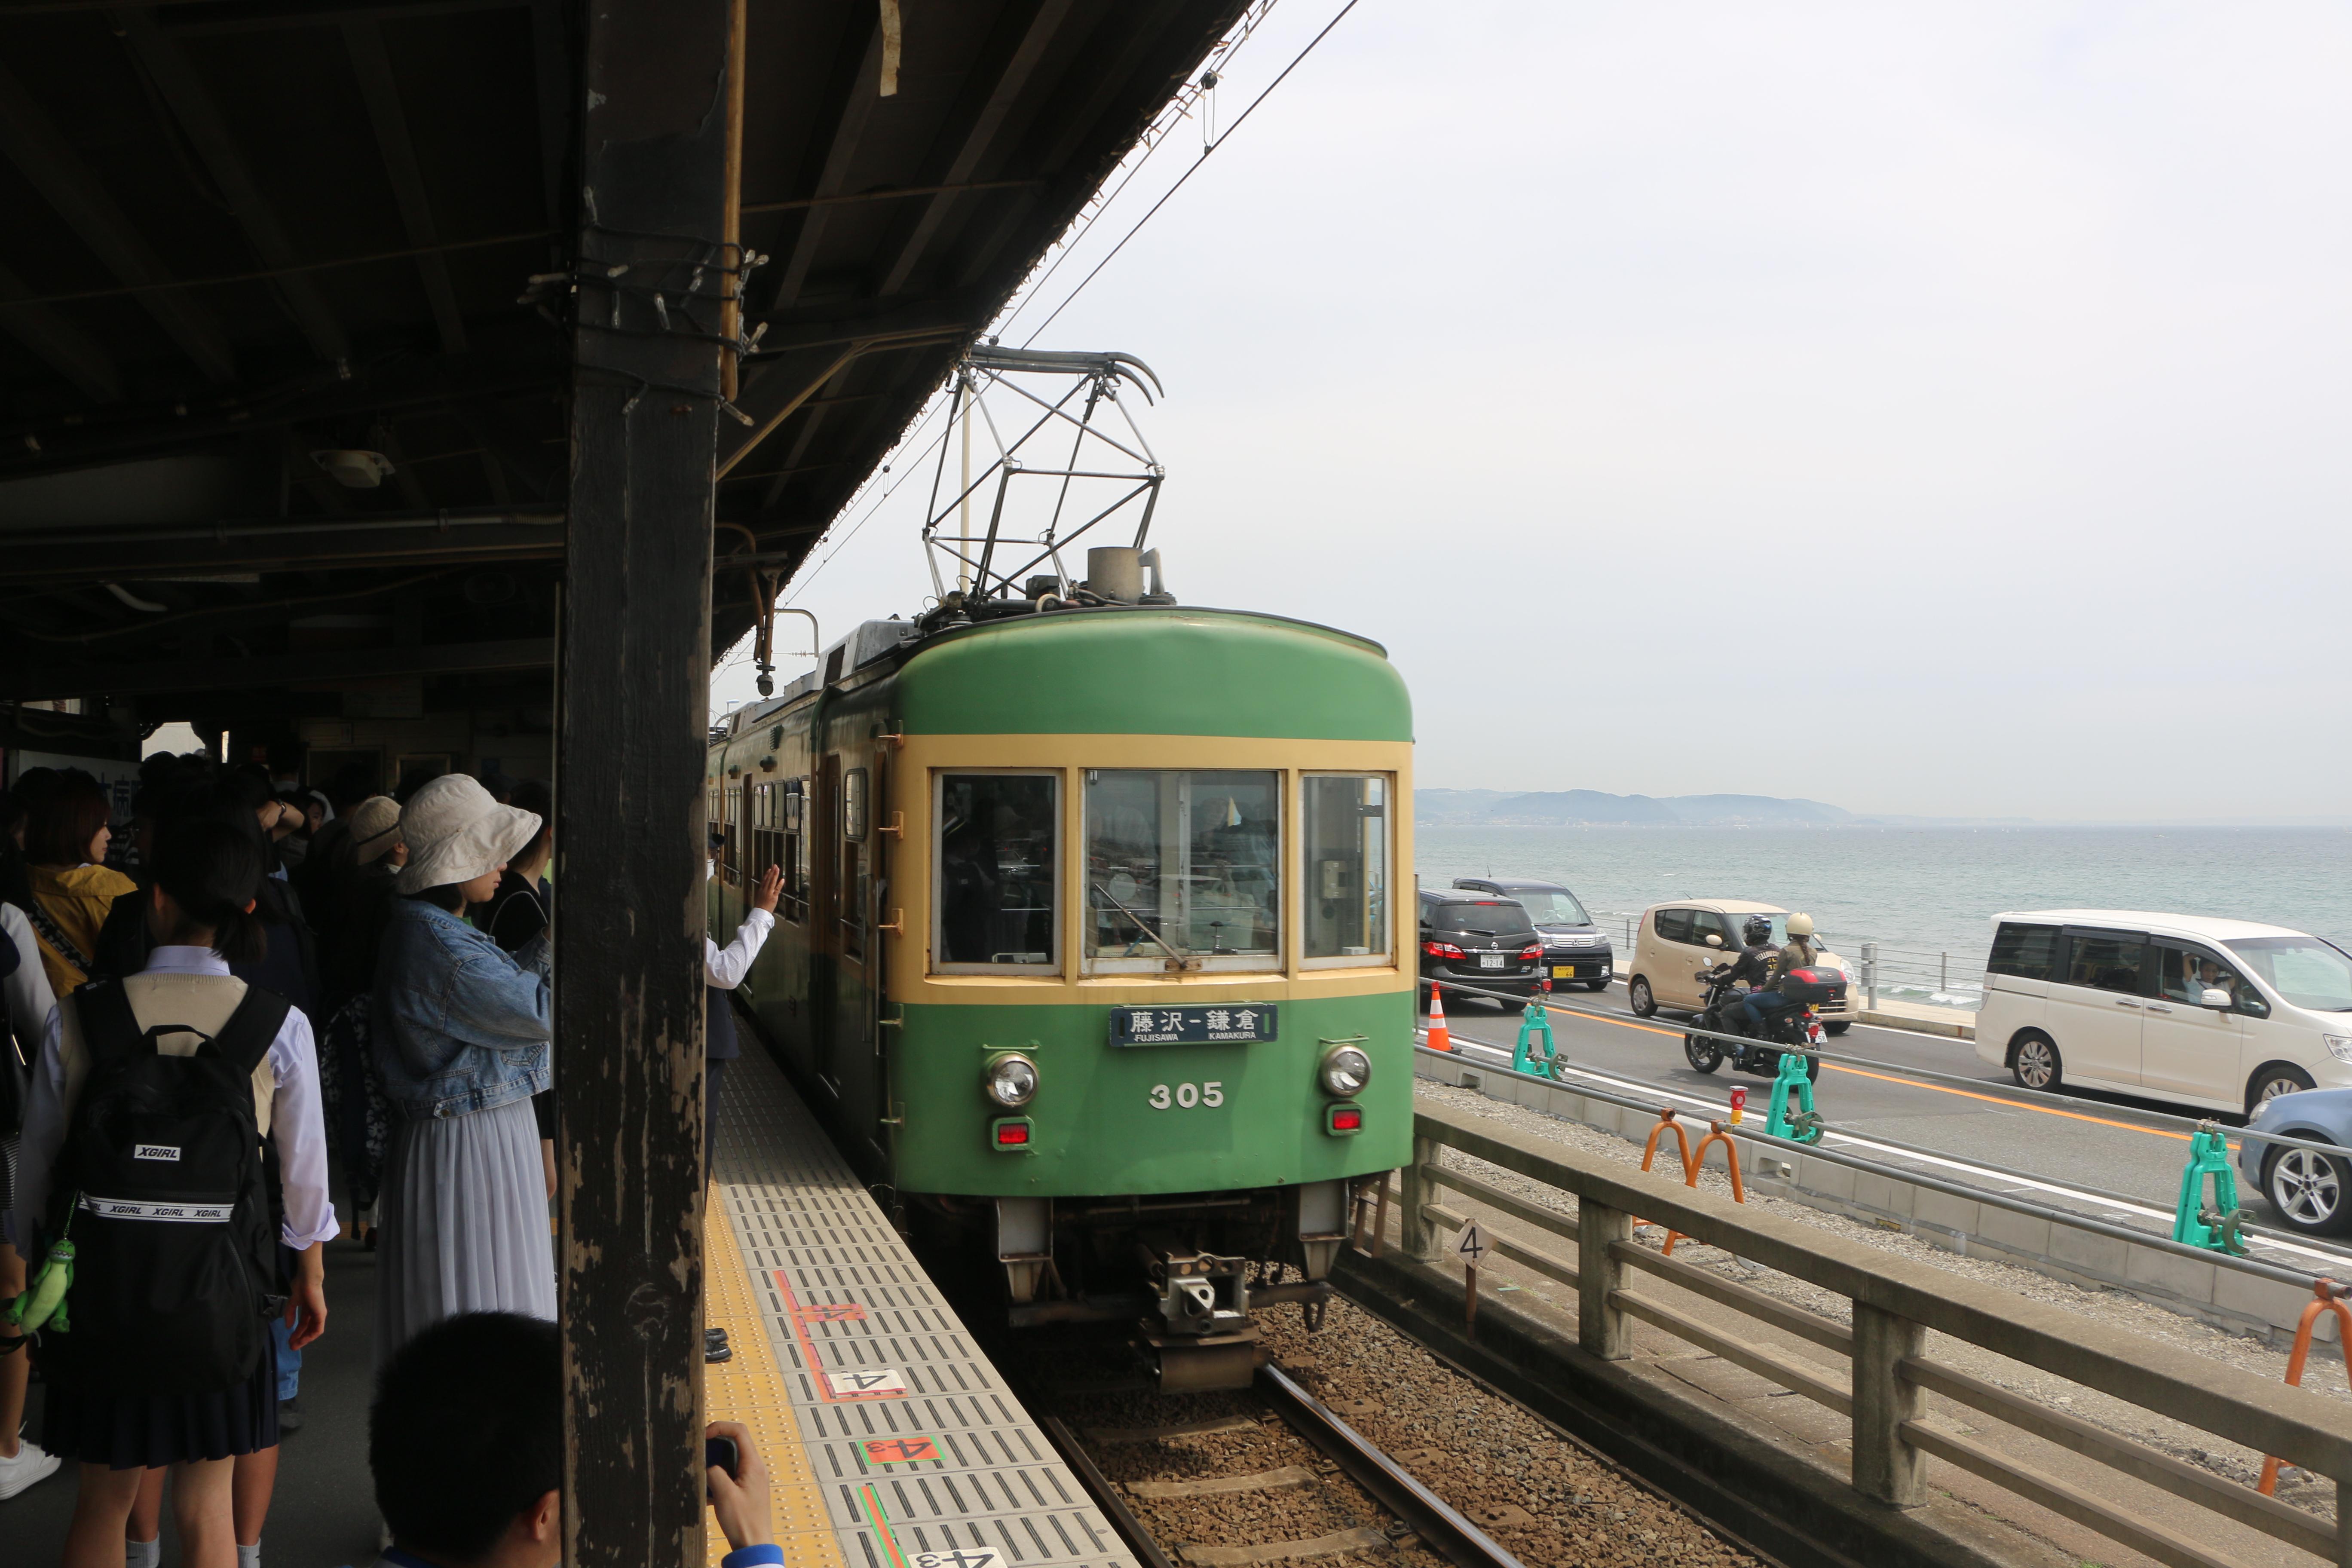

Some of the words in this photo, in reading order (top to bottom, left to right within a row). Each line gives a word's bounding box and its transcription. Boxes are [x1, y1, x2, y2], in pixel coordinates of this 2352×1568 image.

[1135, 1033, 1179, 1041] FUJISAWA
[1148, 1081, 1224, 1109] 305
[138, 1147, 177, 1158] XGIRL
[110, 1205, 141, 1214] XGIRL
[153, 1208, 184, 1216] XGIRL
[1460, 1226, 1483, 1258] 4
[843, 1374, 888, 1389] 4
